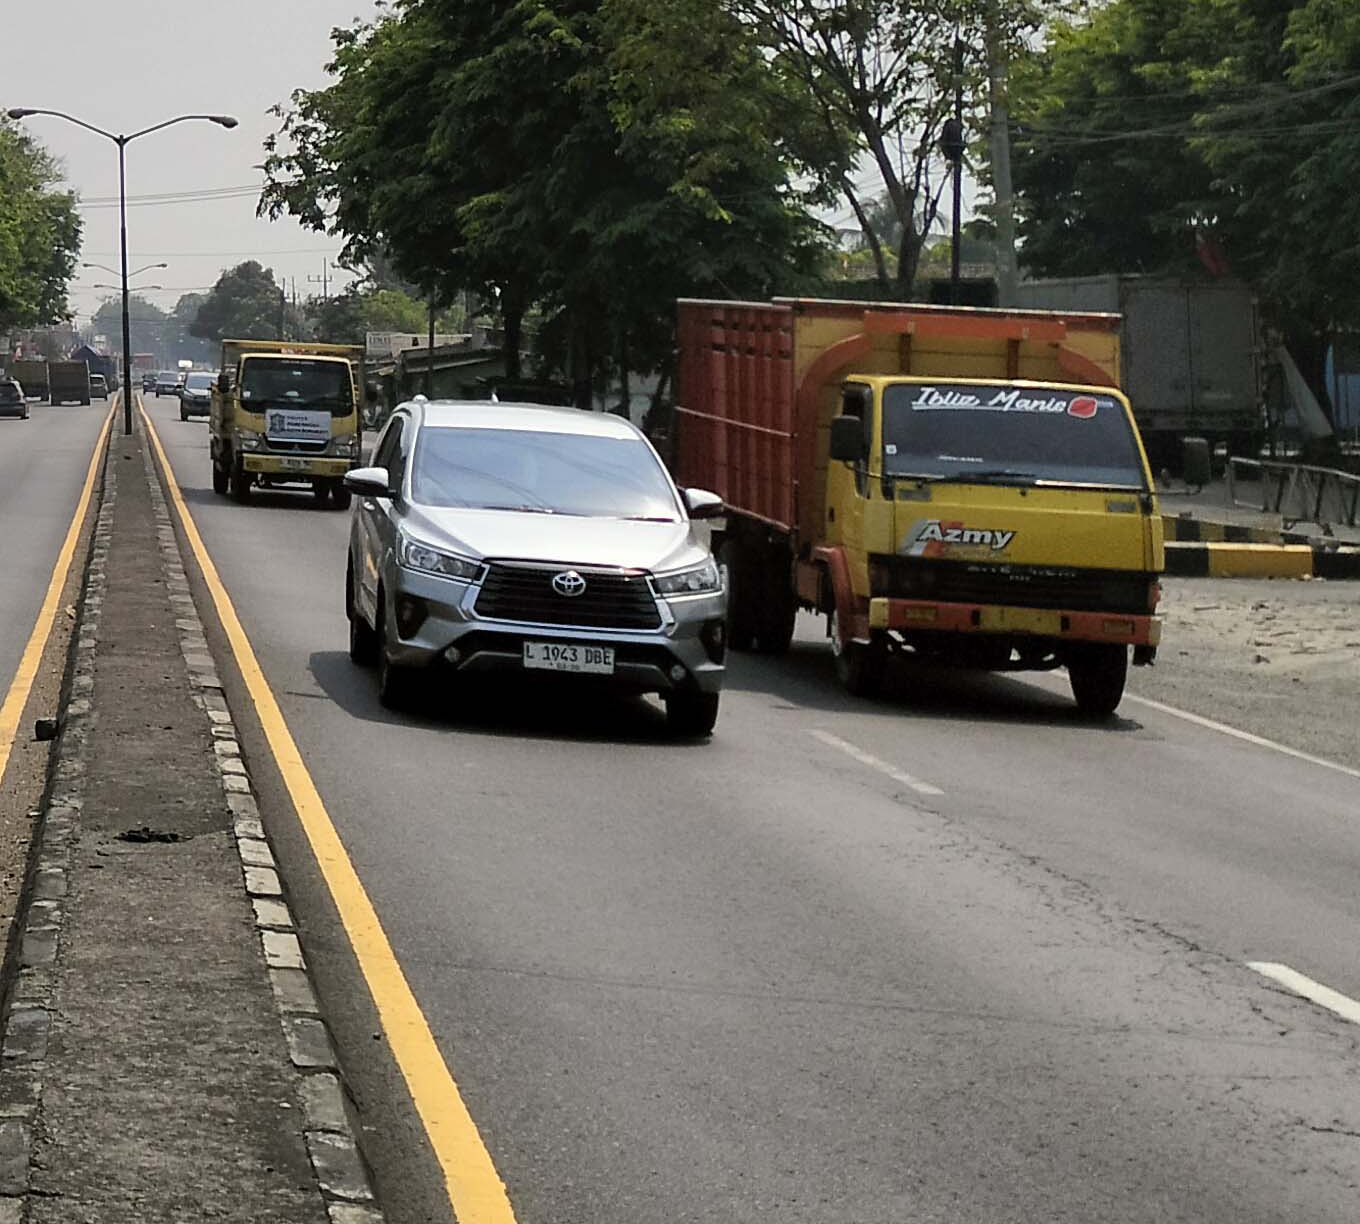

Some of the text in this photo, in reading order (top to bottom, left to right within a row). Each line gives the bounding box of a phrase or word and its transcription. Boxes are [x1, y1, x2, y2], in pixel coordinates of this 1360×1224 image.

[917, 520, 1016, 550] Azmy
[525, 644, 534, 659] L
[585, 648, 612, 665] DBE
